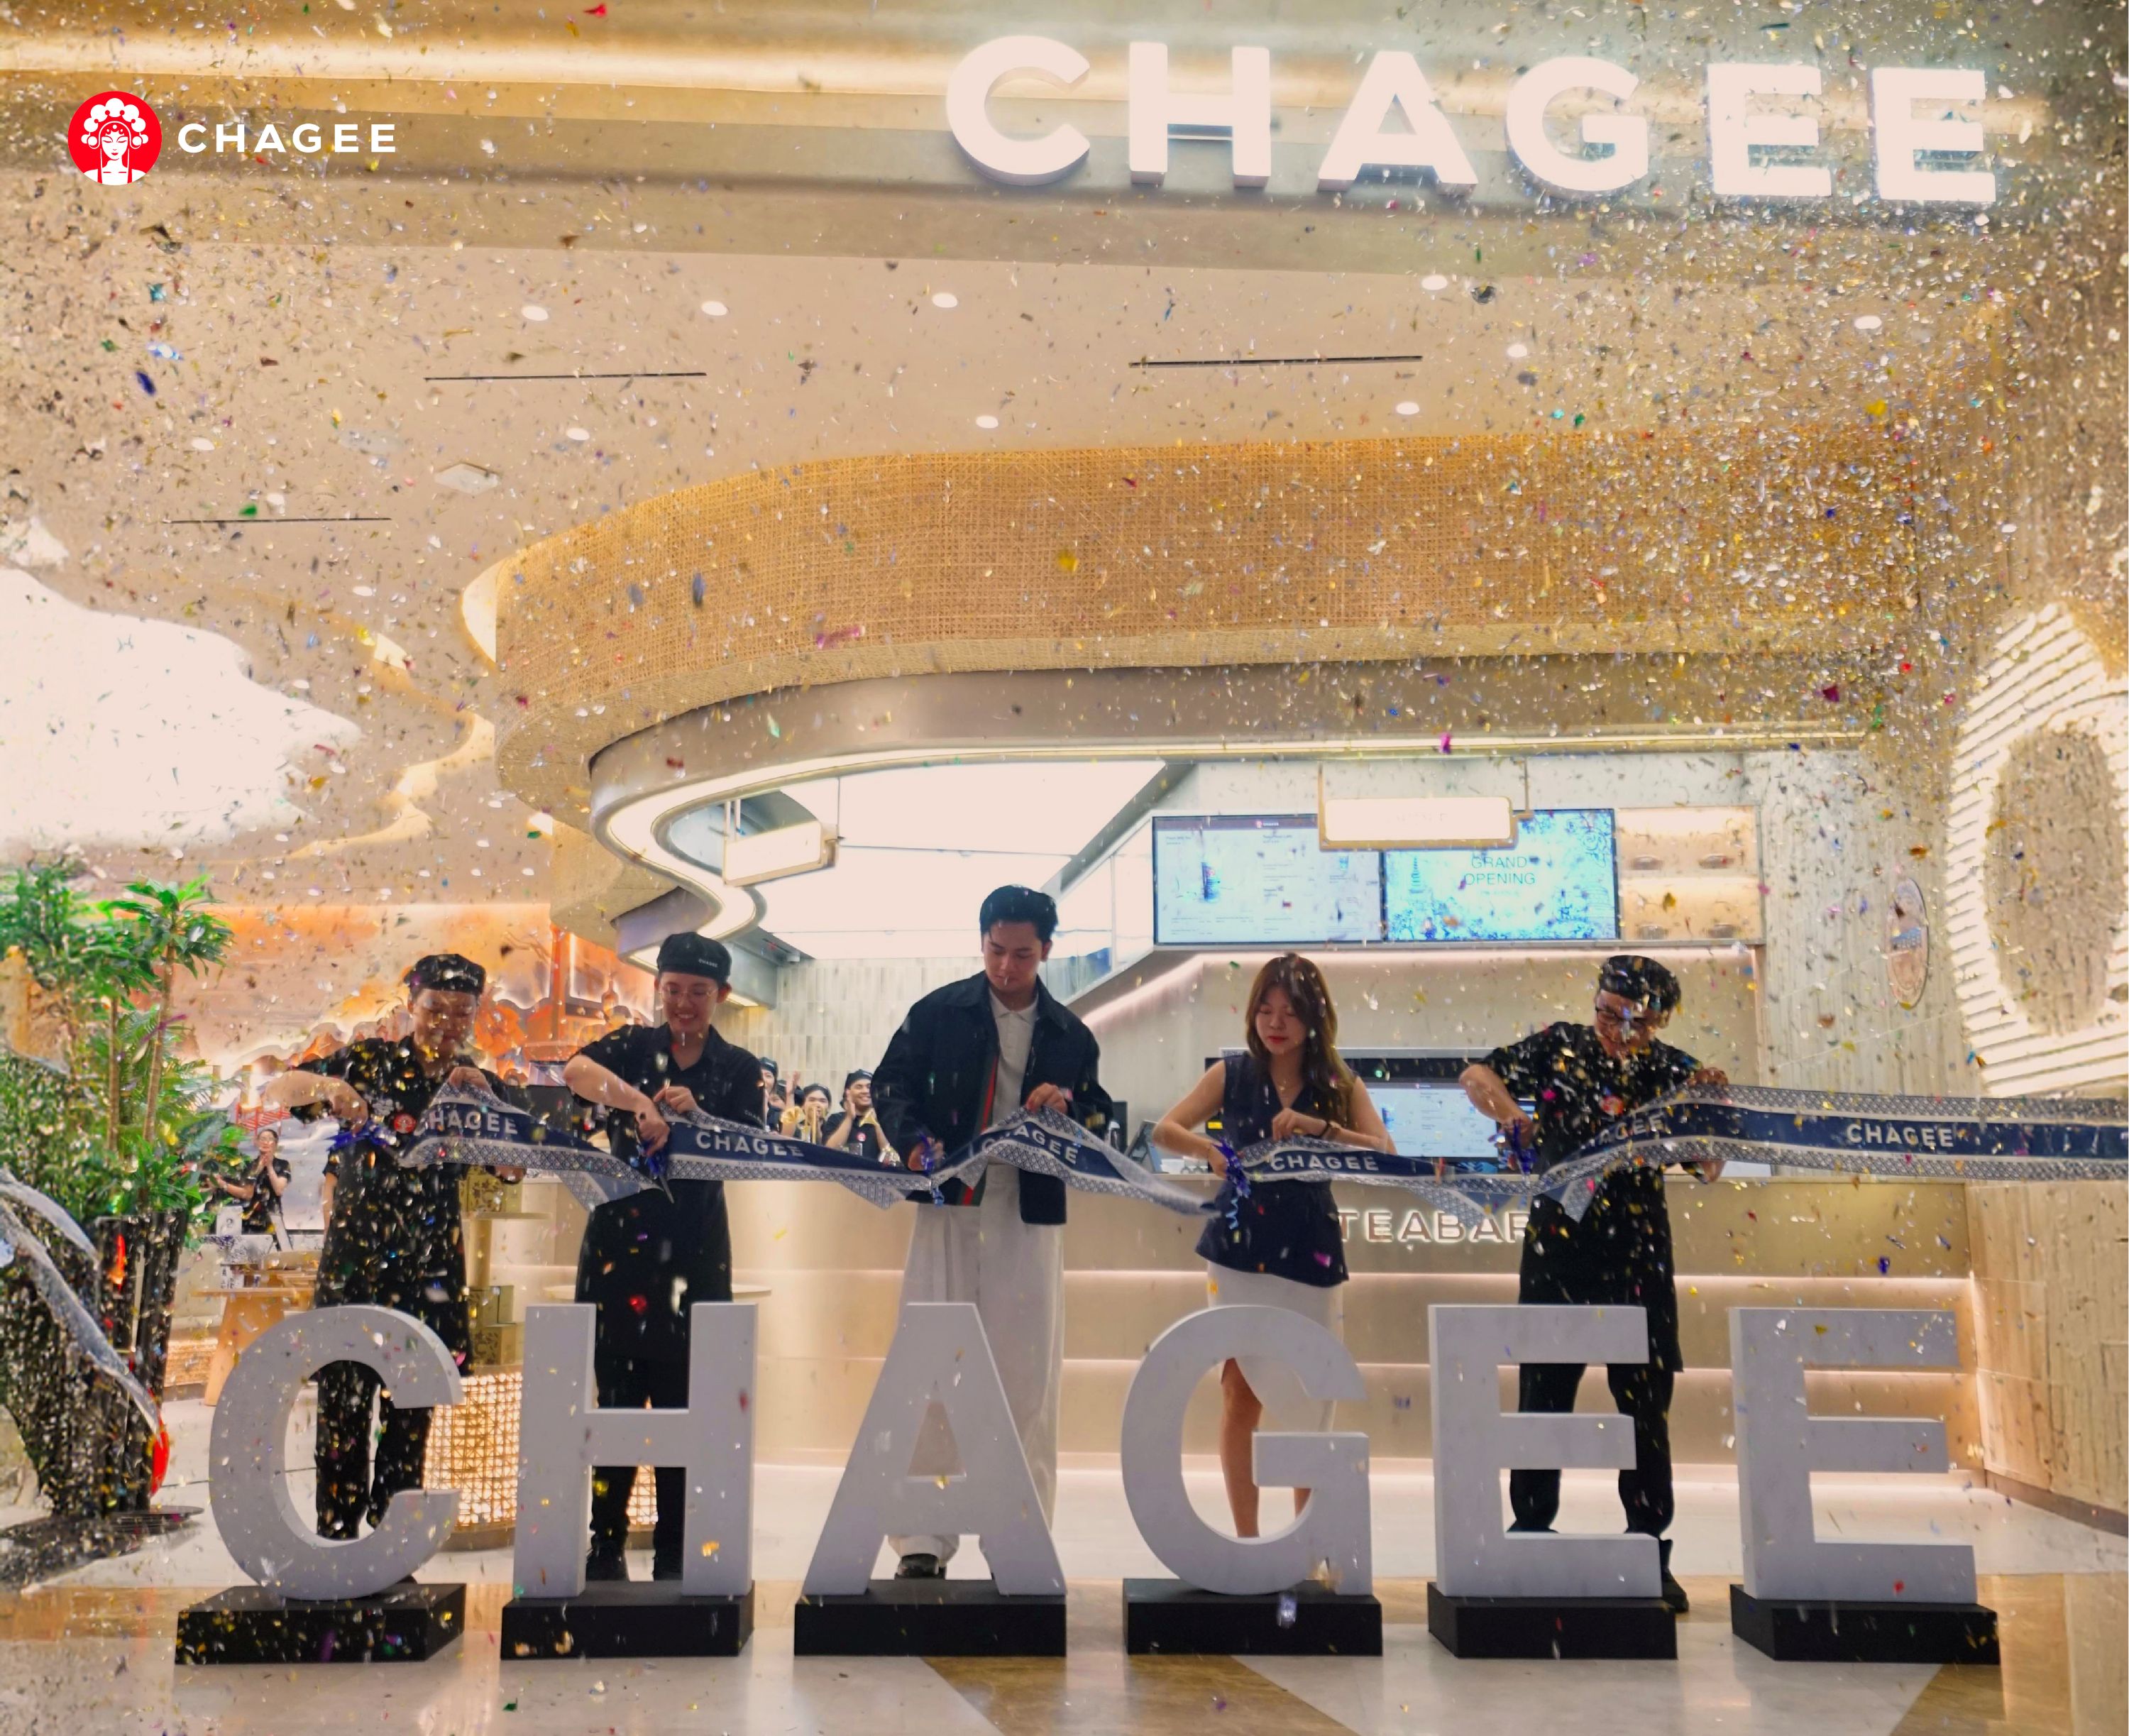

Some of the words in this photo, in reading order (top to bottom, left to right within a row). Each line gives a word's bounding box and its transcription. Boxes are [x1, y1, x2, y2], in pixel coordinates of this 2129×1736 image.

[945, 35, 1997, 202] CHAGEE
[1471, 856, 1528, 869] GRAND
[1465, 872, 1536, 885] OPENING
[427, 1108, 518, 1134] HAGEE
[695, 1131, 805, 1157] CHAGEE
[1846, 1124, 1954, 1148] CHAGEE
[1270, 1154, 1380, 1172] CHAGEE
[209, 1303, 1978, 1603] CHAGEE
